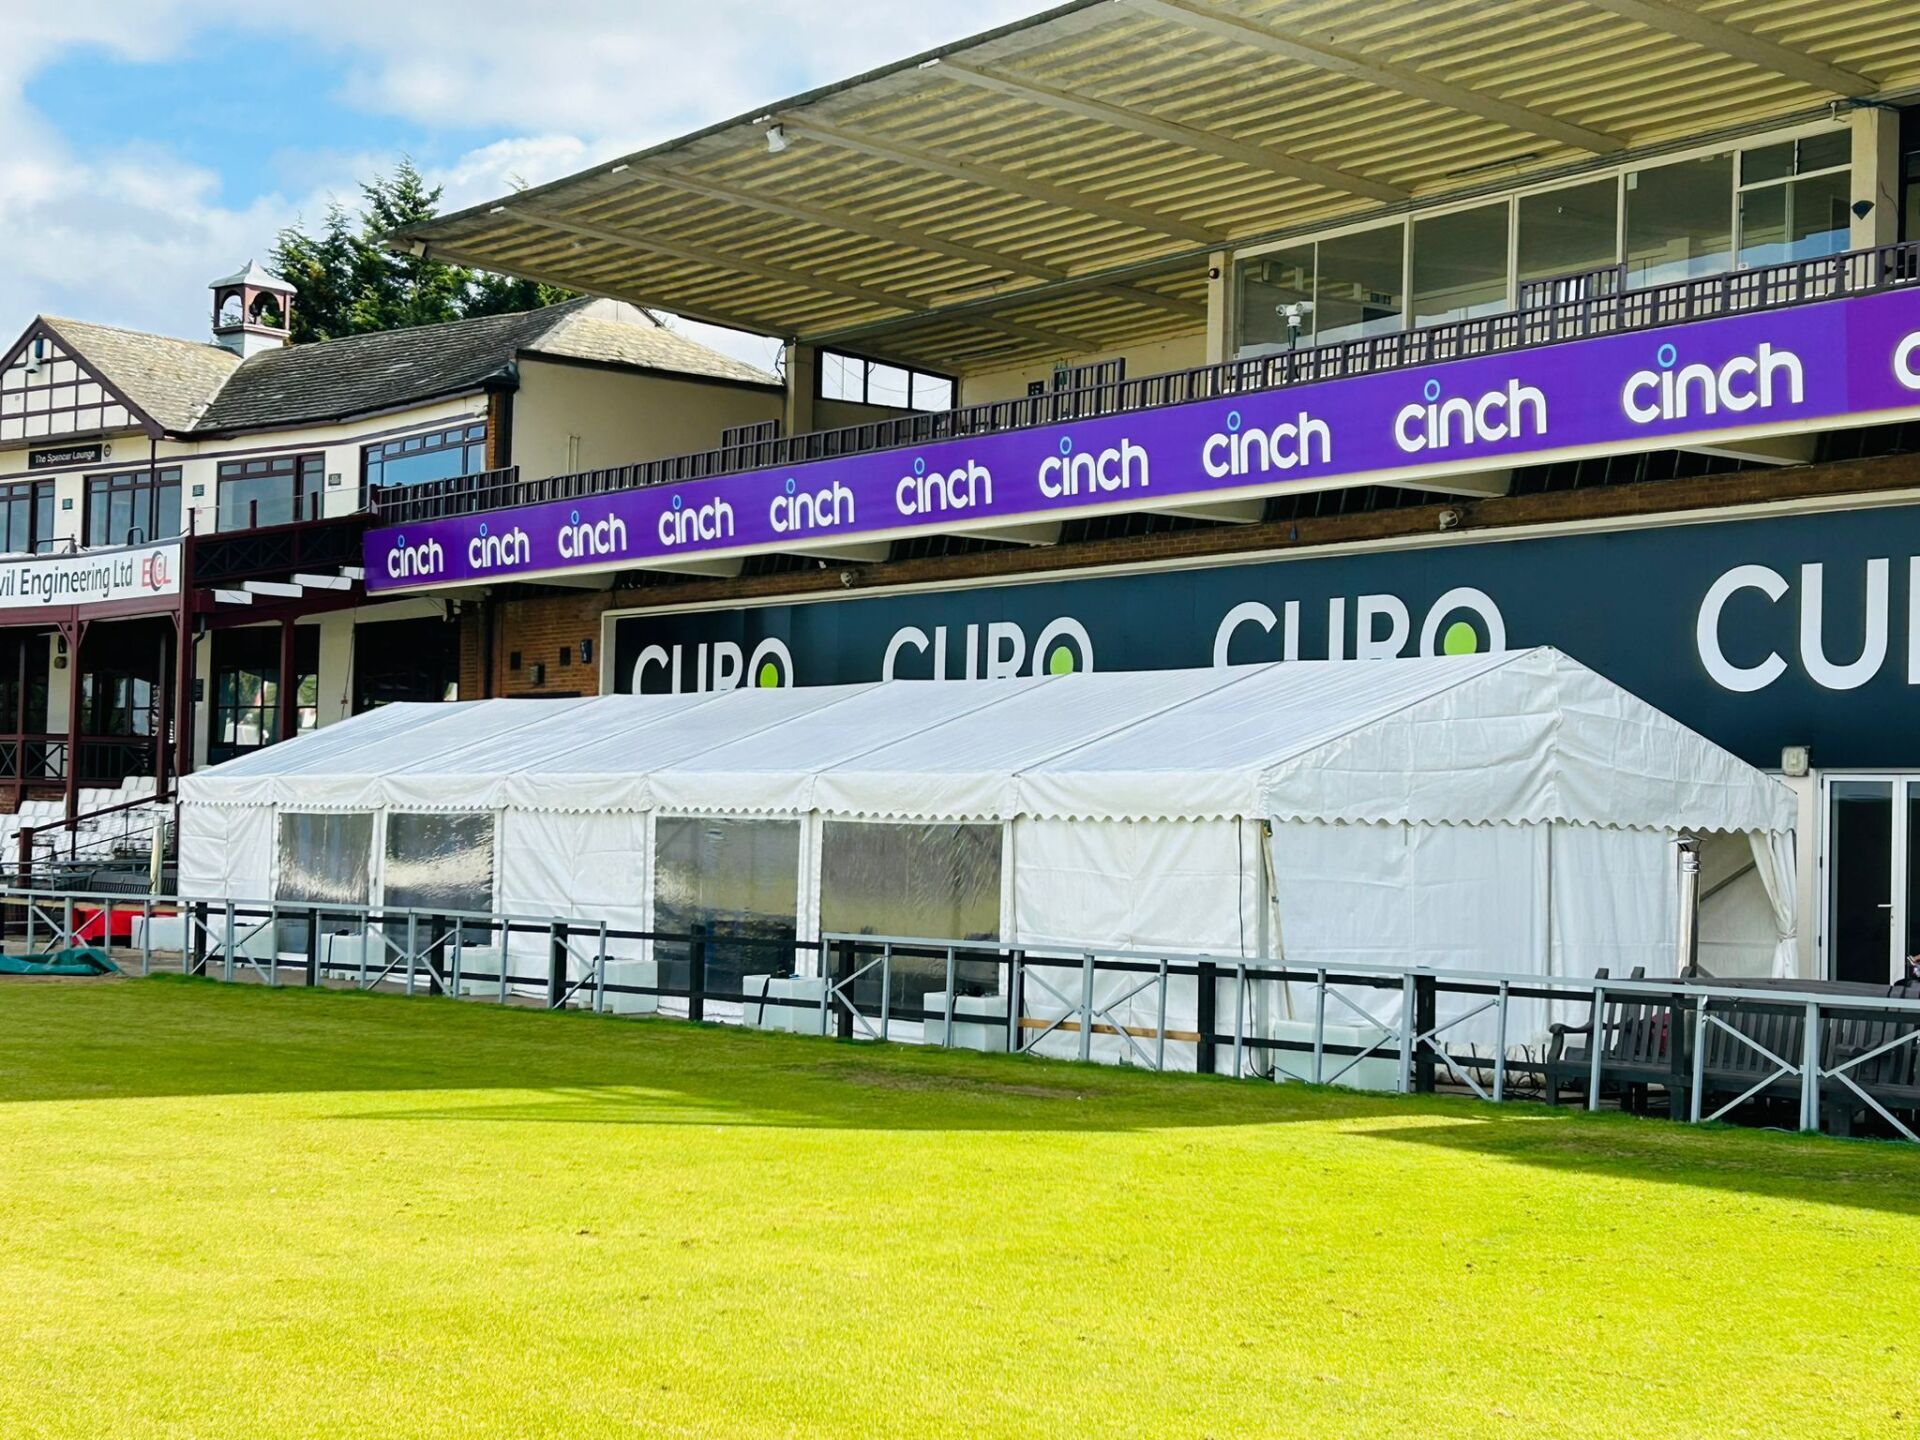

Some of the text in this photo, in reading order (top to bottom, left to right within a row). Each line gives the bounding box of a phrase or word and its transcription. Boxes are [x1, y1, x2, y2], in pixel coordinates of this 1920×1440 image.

[1620, 341, 1804, 426] cinch
[1393, 378, 1548, 454] cinch
[35, 450, 96, 464] The Spencer Lounge
[1038, 436, 1150, 499] cinch
[1201, 410, 1332, 479] cinch
[769, 477, 855, 533] cinch
[895, 456, 993, 516] cinch
[468, 523, 531, 569] cinch
[558, 510, 628, 559] cinch
[657, 494, 735, 546] cinch
[20, 562, 110, 603] Engineering
[113, 557, 133, 588] Ltd
[388, 535, 444, 579] cinch
[1696, 556, 1920, 693] CU
